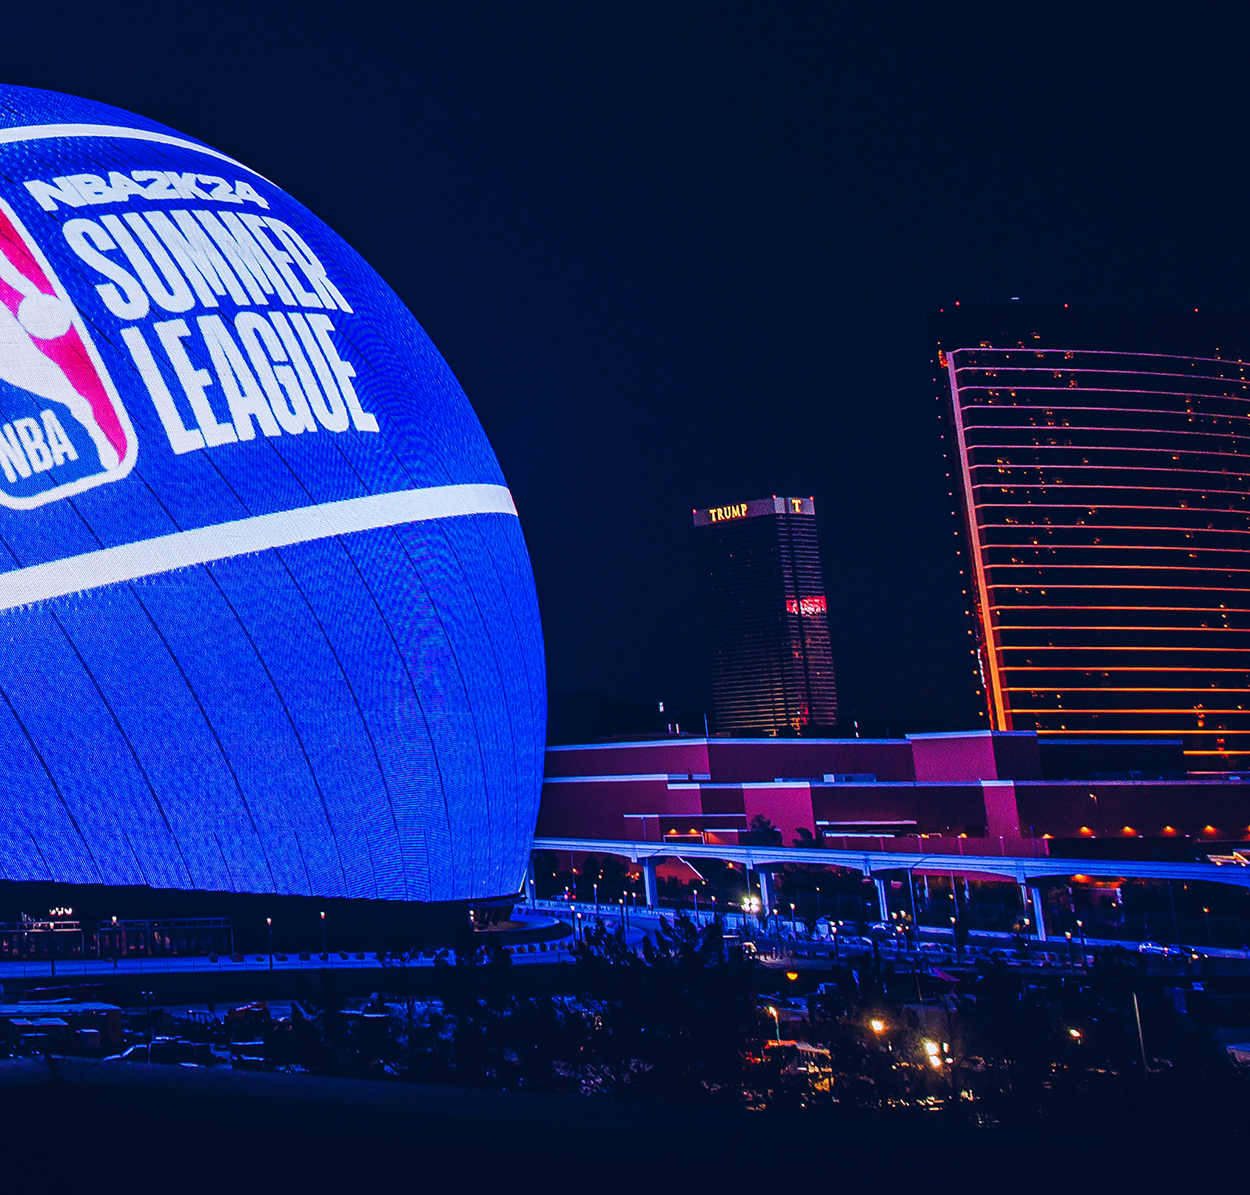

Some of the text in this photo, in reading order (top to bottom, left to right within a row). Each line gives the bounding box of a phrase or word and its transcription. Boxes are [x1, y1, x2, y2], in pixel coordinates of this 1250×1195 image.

[24, 170, 271, 211] NBA2K24
[62, 210, 353, 320] SUMMER
[120, 311, 379, 455] LEAGUE
[709, 503, 748, 522] TRUMP
[791, 499, 802, 512] T
